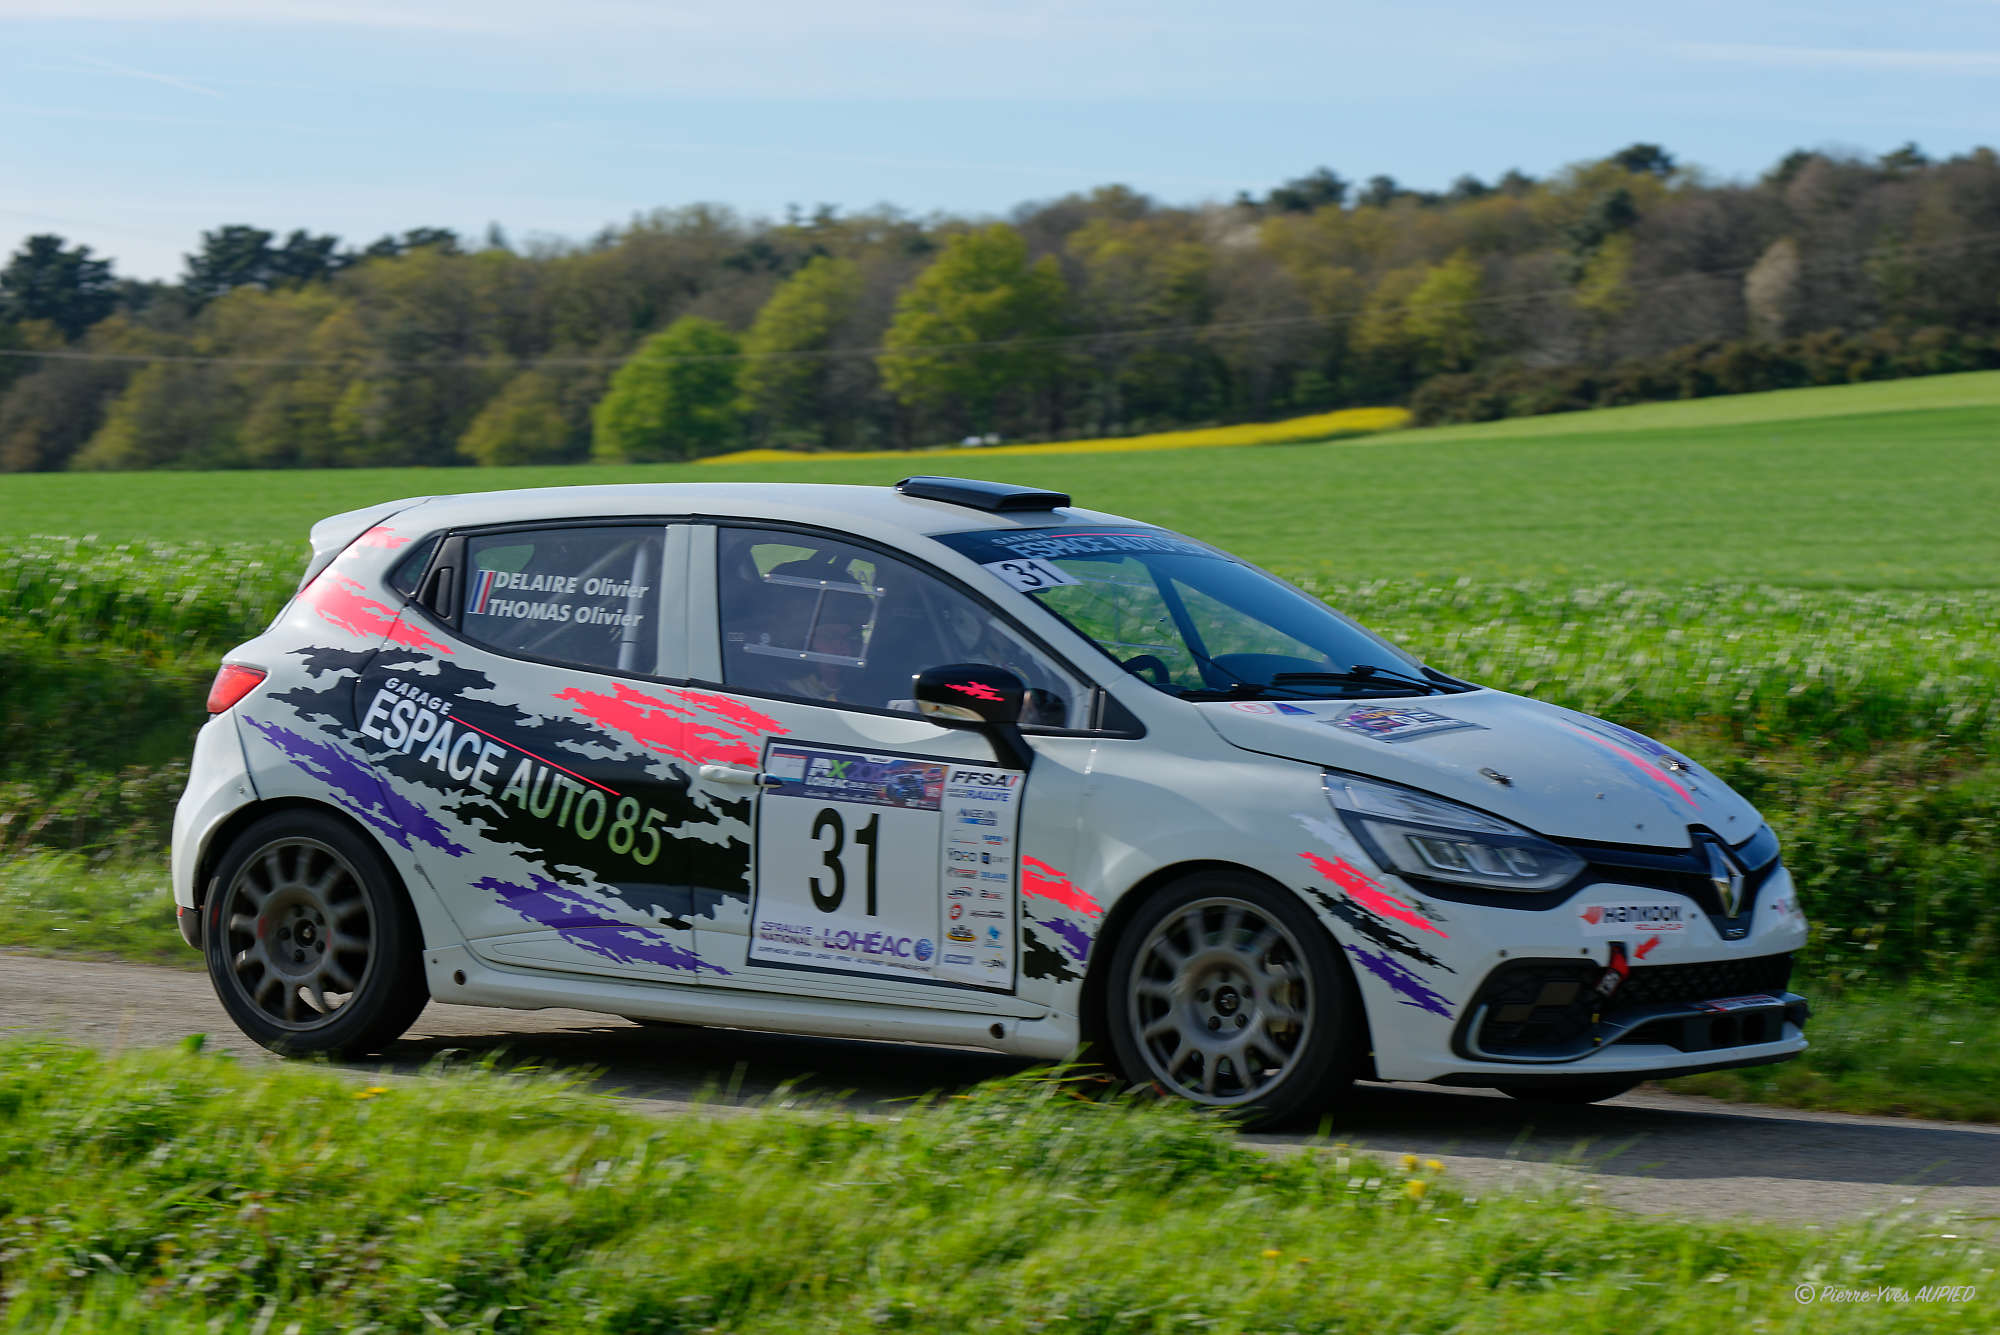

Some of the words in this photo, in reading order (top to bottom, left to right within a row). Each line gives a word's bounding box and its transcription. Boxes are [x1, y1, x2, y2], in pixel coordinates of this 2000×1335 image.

[494, 570, 578, 595] DELAIRE
[583, 577, 650, 600] Olivier
[1002, 562, 1065, 587] 31
[488, 599, 572, 622] THOMAS
[574, 605, 643, 628] Olivier
[384, 676, 454, 717] GARAGE
[359, 690, 508, 794] ESPACE
[502, 758, 607, 840] AUTO
[607, 796, 668, 866] 85
[951, 771, 1008, 787] FFSA
[809, 807, 880, 916] 31
[759, 932, 813, 947] NATIONAL
[824, 928, 912, 958] LOHÉAC
